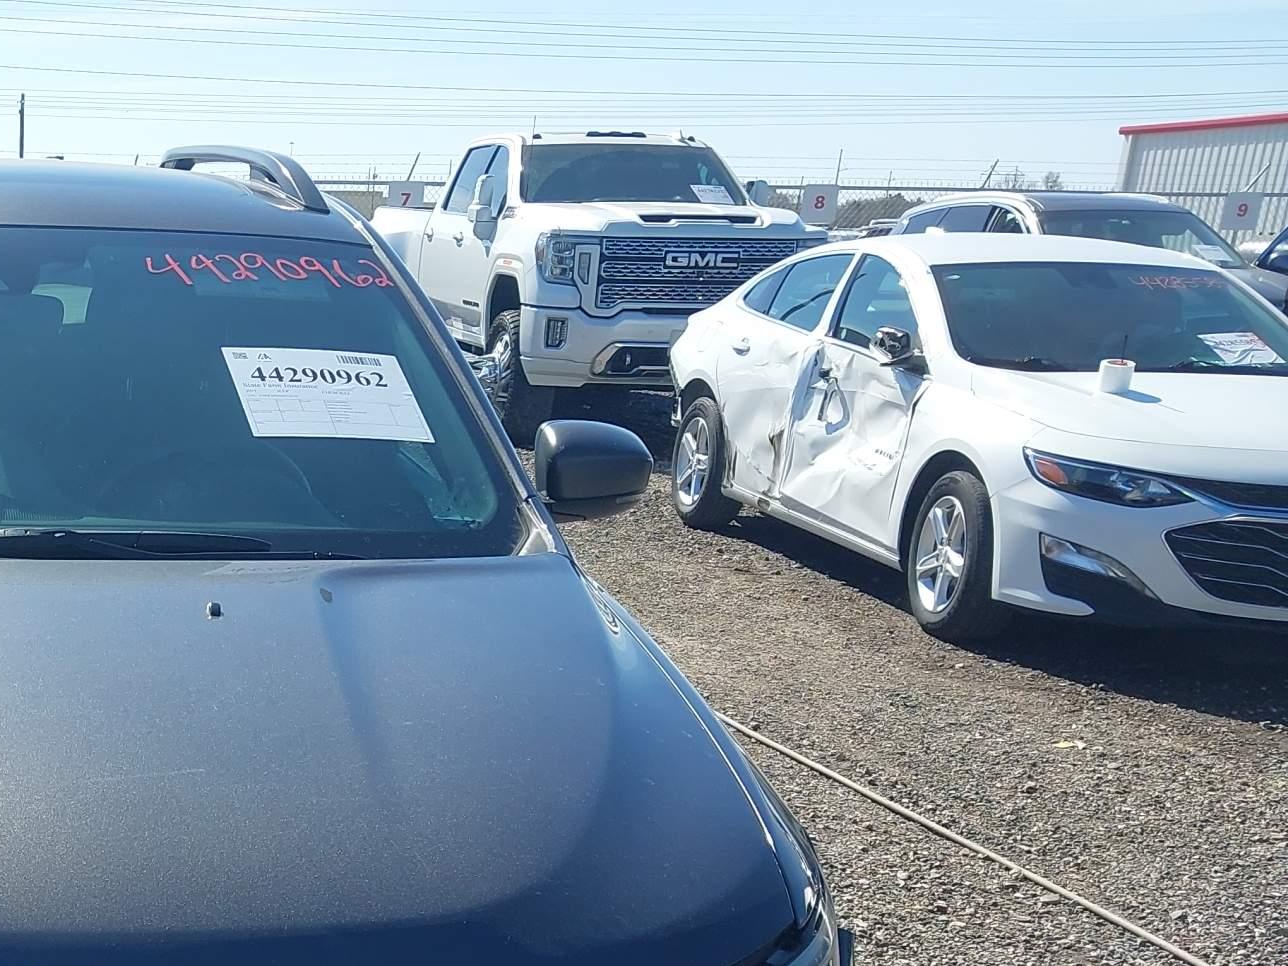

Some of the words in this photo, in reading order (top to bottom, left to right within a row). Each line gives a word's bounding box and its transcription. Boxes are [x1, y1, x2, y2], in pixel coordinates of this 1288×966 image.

[400, 192, 412, 206] 7
[814, 195, 826, 210] 8
[1236, 203, 1248, 217] 9
[665, 252, 739, 268] GMC
[145, 253, 395, 289] 44290962
[250, 365, 389, 388] 44290962
